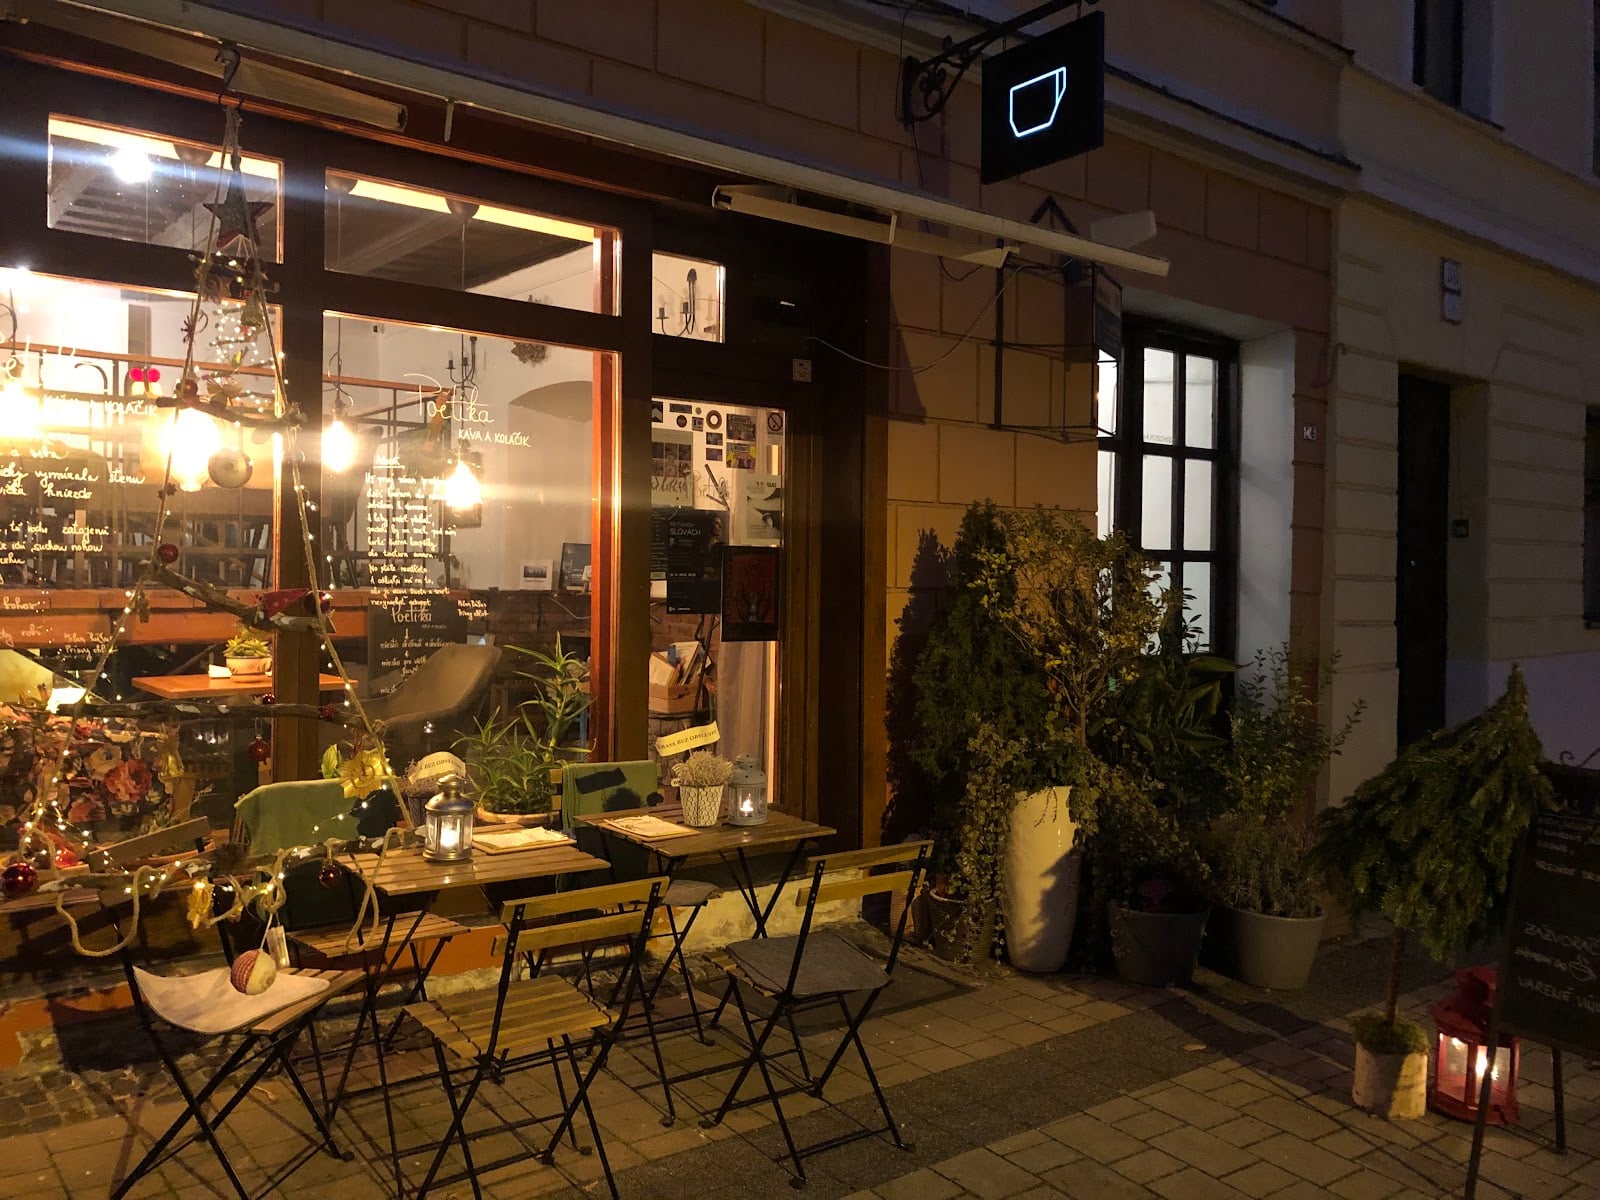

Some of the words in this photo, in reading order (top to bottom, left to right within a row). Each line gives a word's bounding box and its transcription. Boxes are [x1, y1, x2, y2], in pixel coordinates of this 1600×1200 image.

[404, 373, 494, 423] Poetika
[458, 428, 483, 442] KÁVA
[485, 434, 492, 443] A
